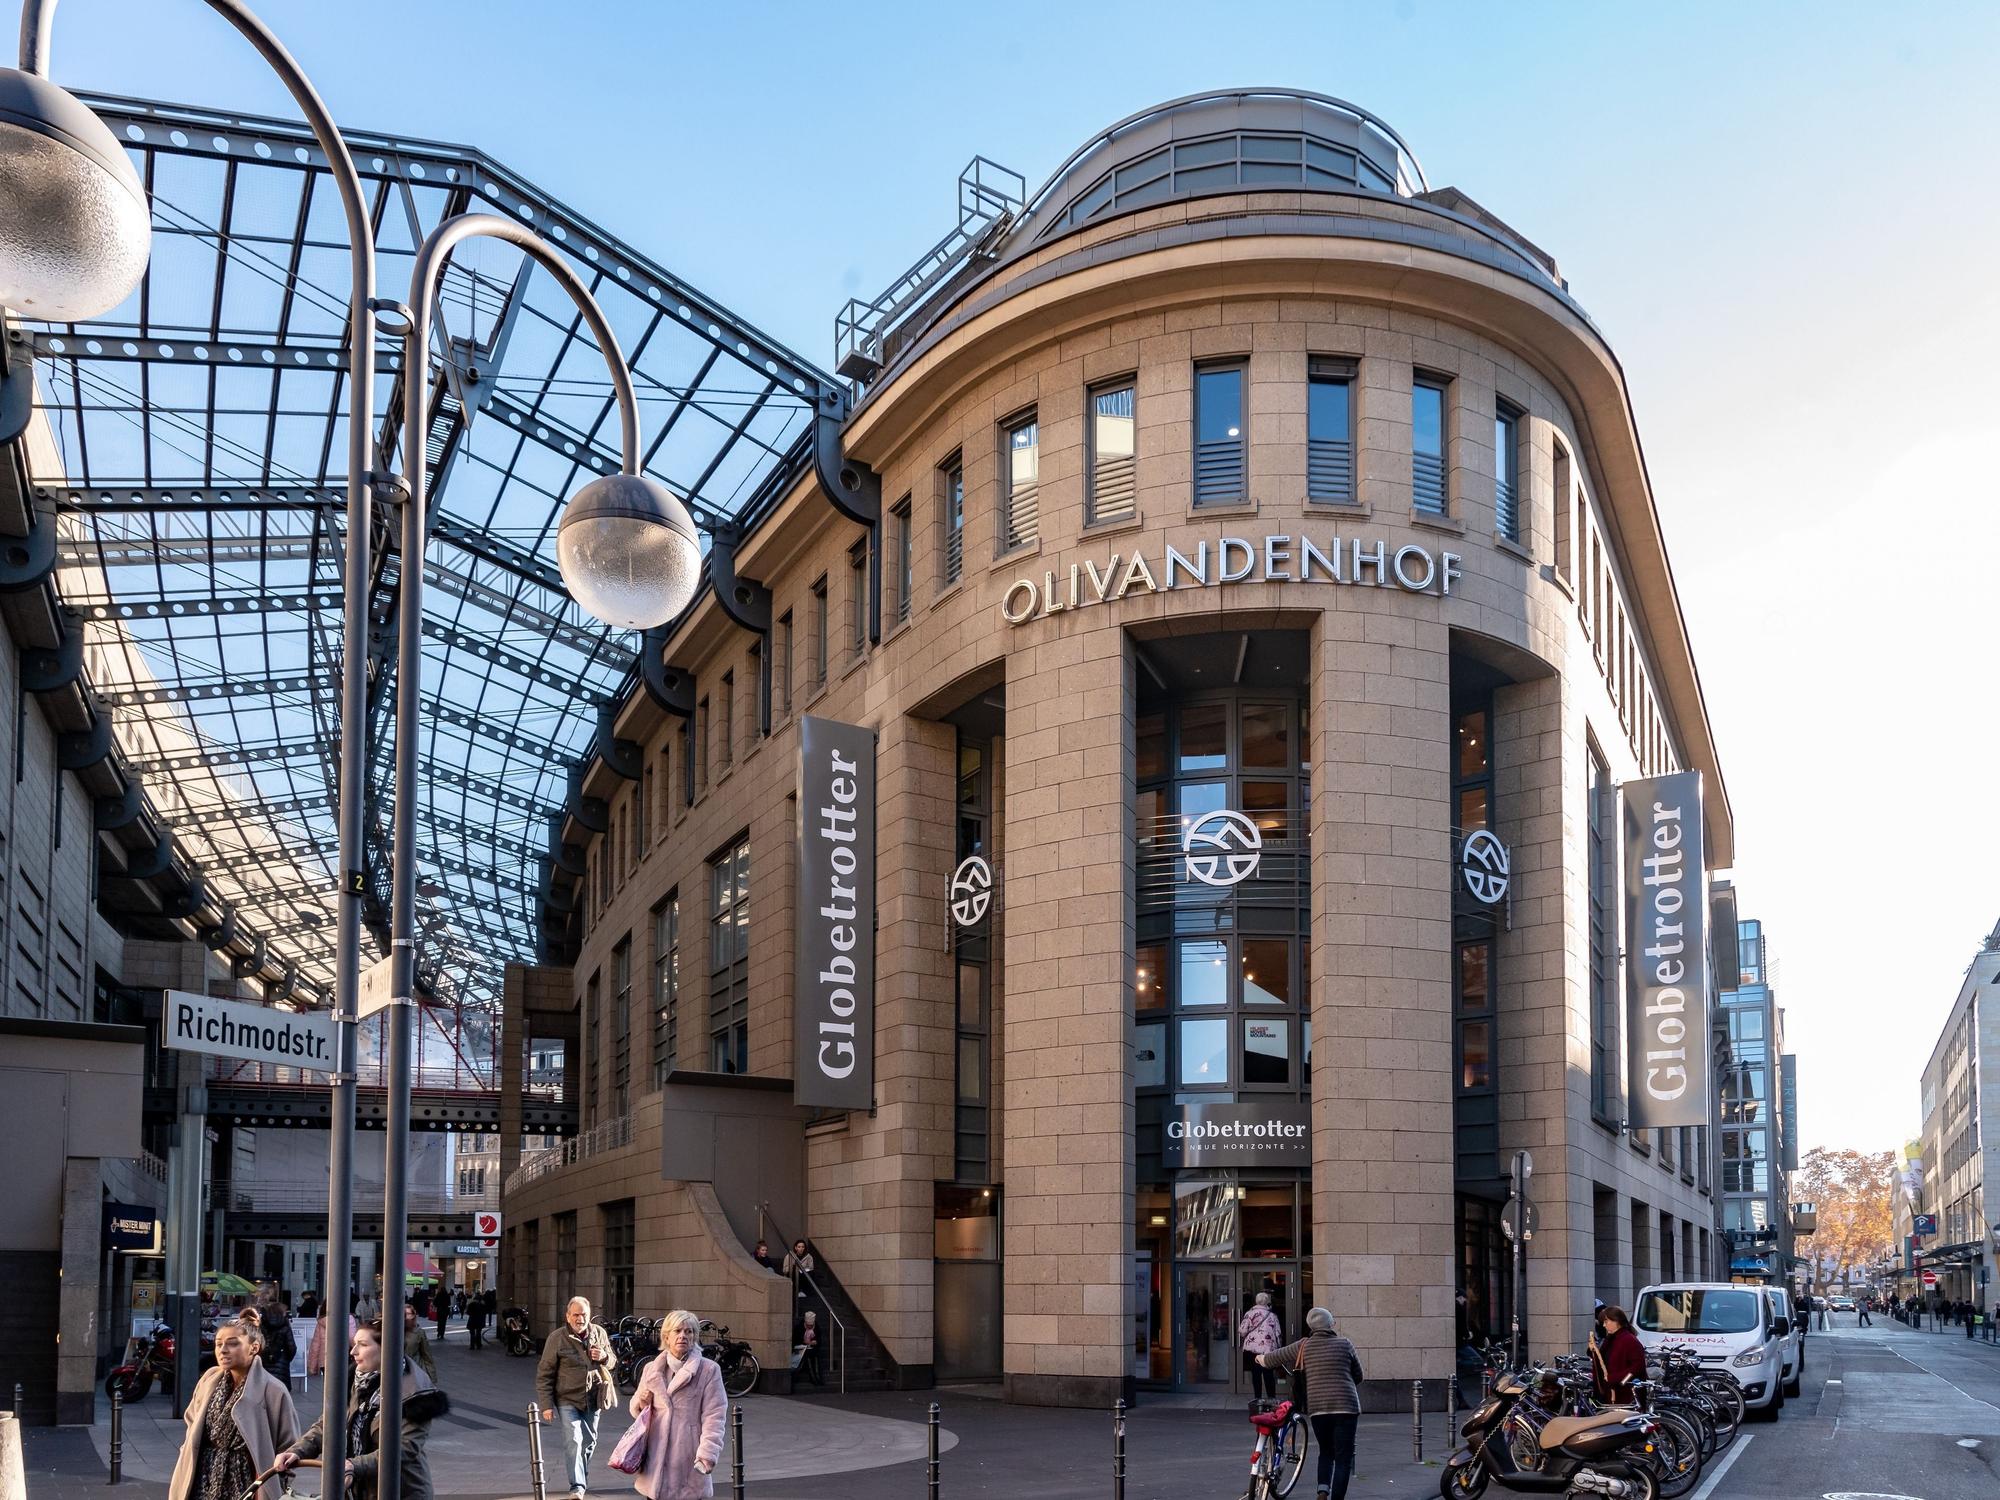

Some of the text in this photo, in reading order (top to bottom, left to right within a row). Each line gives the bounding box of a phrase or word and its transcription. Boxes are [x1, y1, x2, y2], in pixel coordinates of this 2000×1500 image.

[1001, 535, 1462, 626] OLIVANDENHOF
[355, 874, 364, 890] 2
[818, 748, 857, 1080] Globetrotter
[1643, 801, 1687, 1101] Globetrotter
[177, 1003, 330, 1060] Richmodstr.
[1167, 1120, 1306, 1139] Globetrotter
[1189, 1143, 1217, 1151] NEUE
